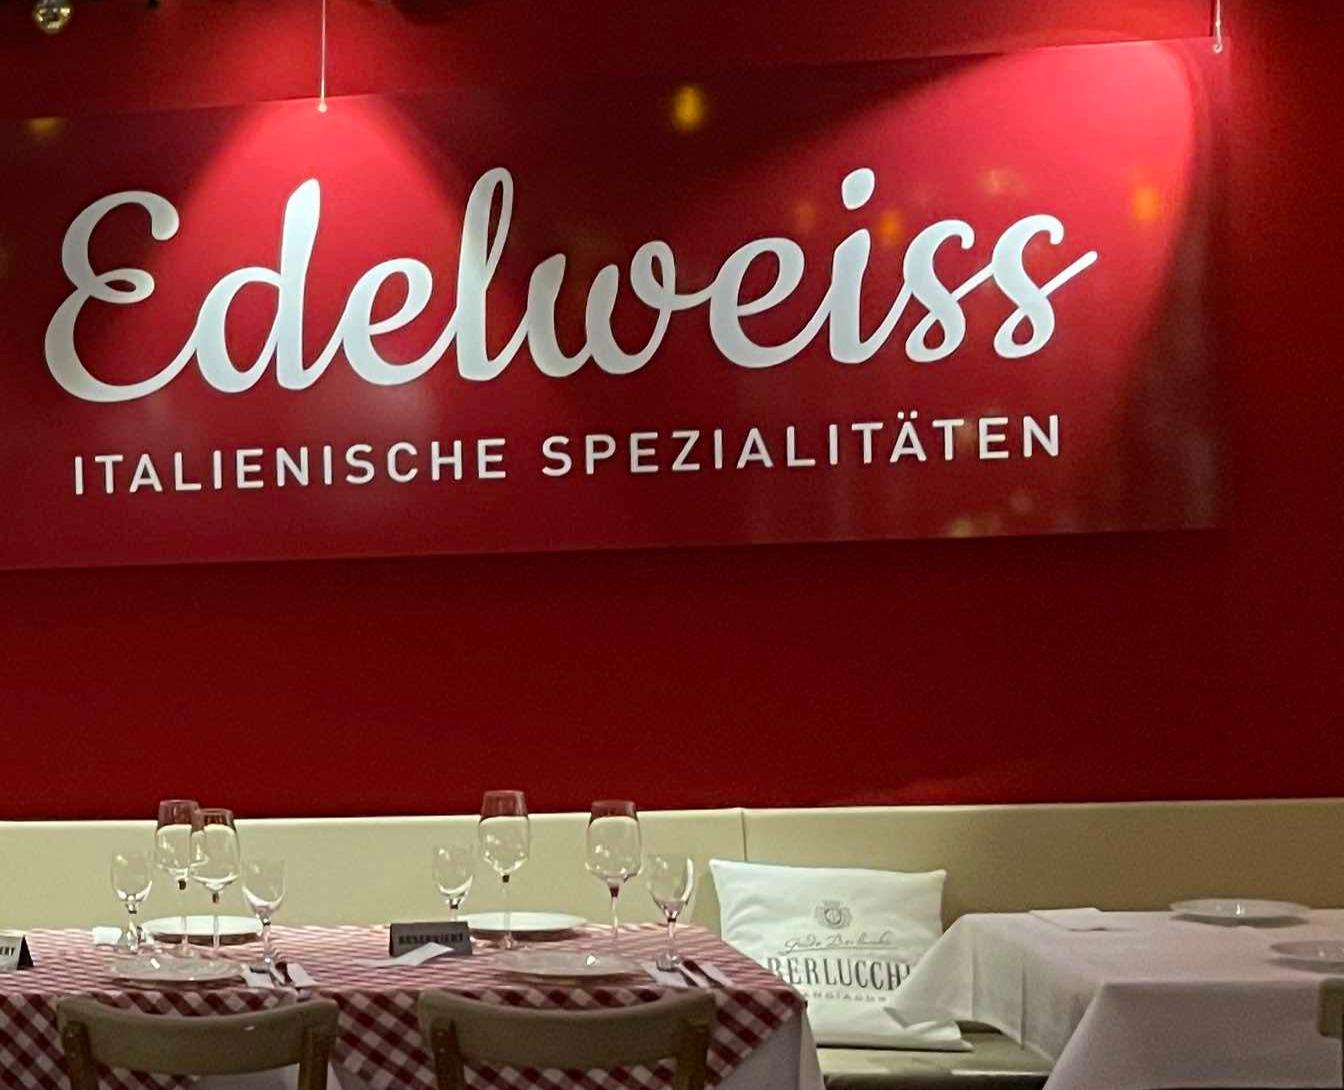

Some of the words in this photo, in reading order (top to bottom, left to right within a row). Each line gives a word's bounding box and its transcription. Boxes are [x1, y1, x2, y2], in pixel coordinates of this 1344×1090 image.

[44, 167, 1099, 402] Edelweiss
[74, 438, 507, 496] ITALIENISCHE
[542, 410, 1060, 477] SPEZIALITÄTEN
